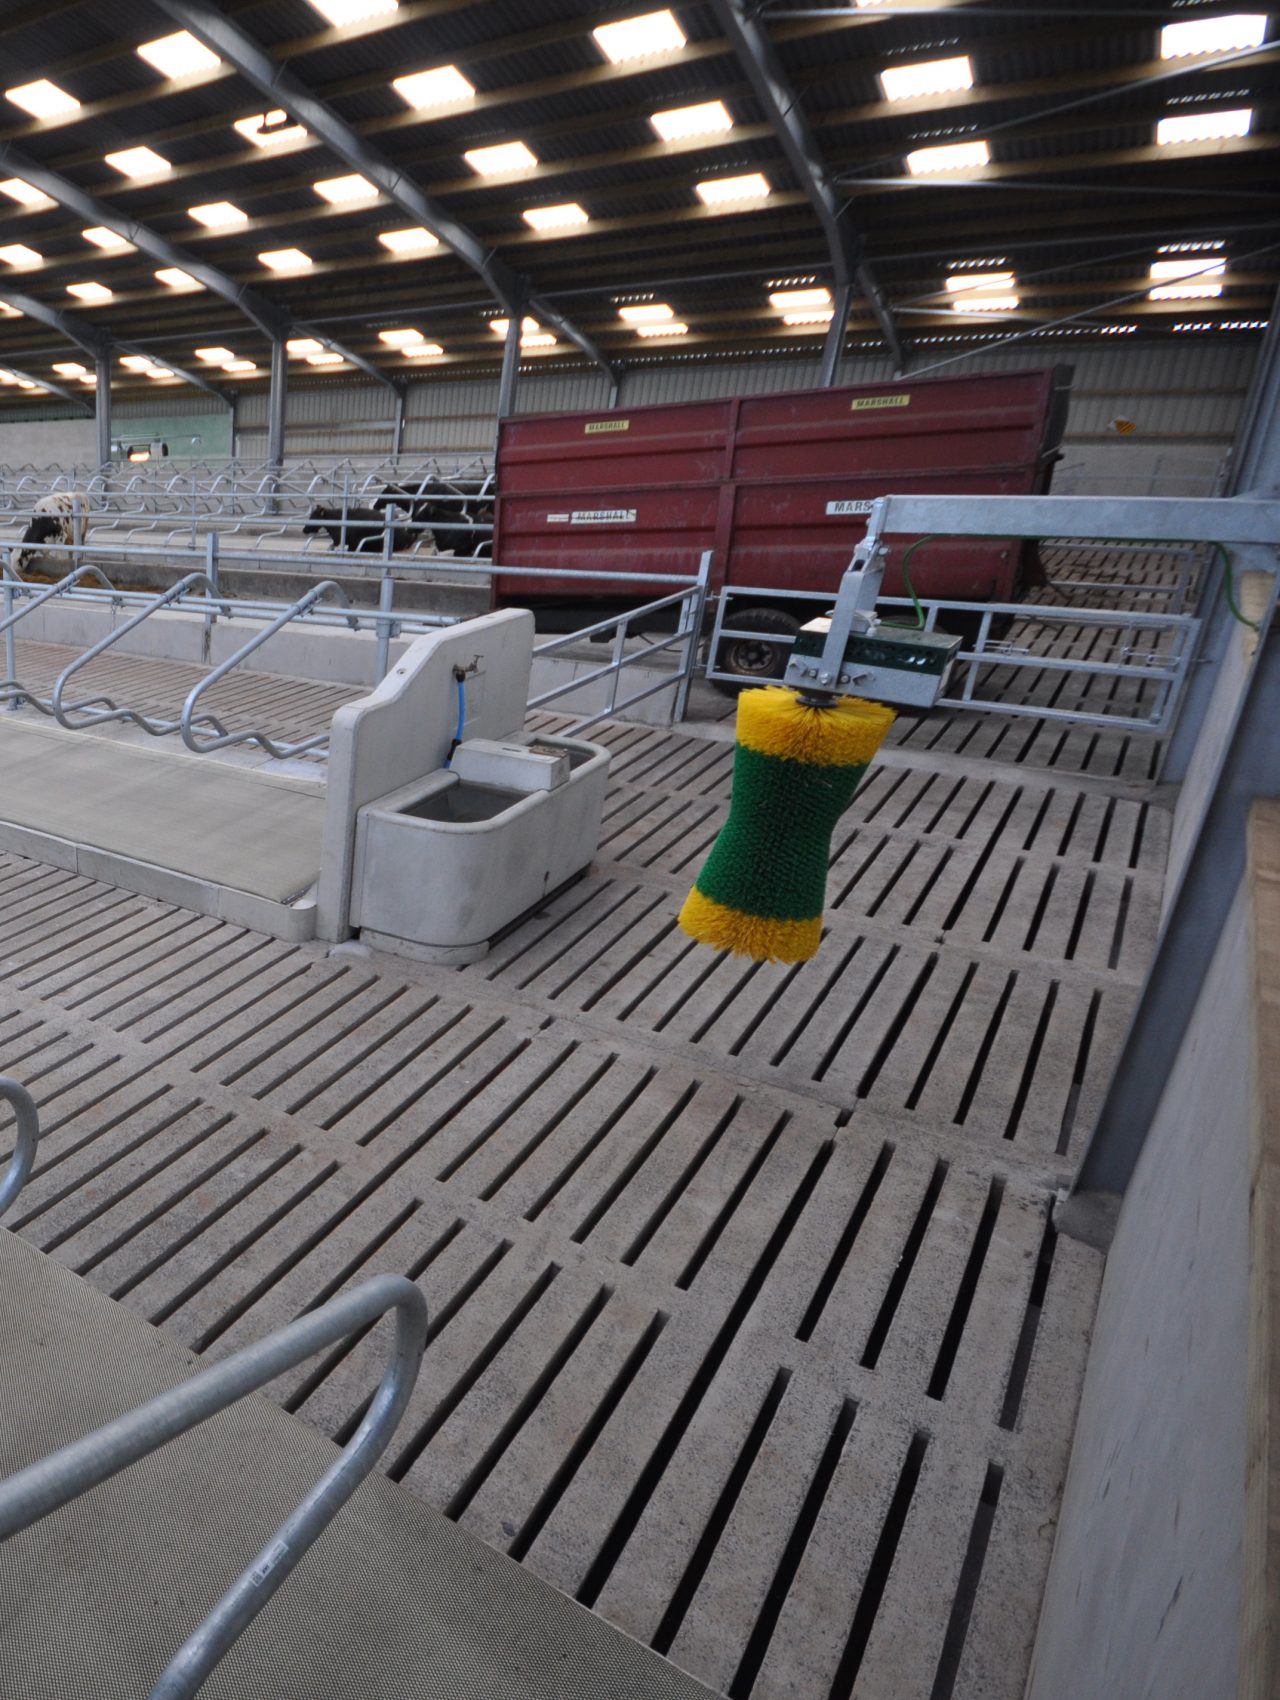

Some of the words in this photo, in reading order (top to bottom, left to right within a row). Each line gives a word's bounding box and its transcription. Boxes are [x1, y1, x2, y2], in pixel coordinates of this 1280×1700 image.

[856, 396, 904, 407] MARSHALL
[588, 421, 625, 430] MARSHALL
[834, 501, 872, 512] MARS
